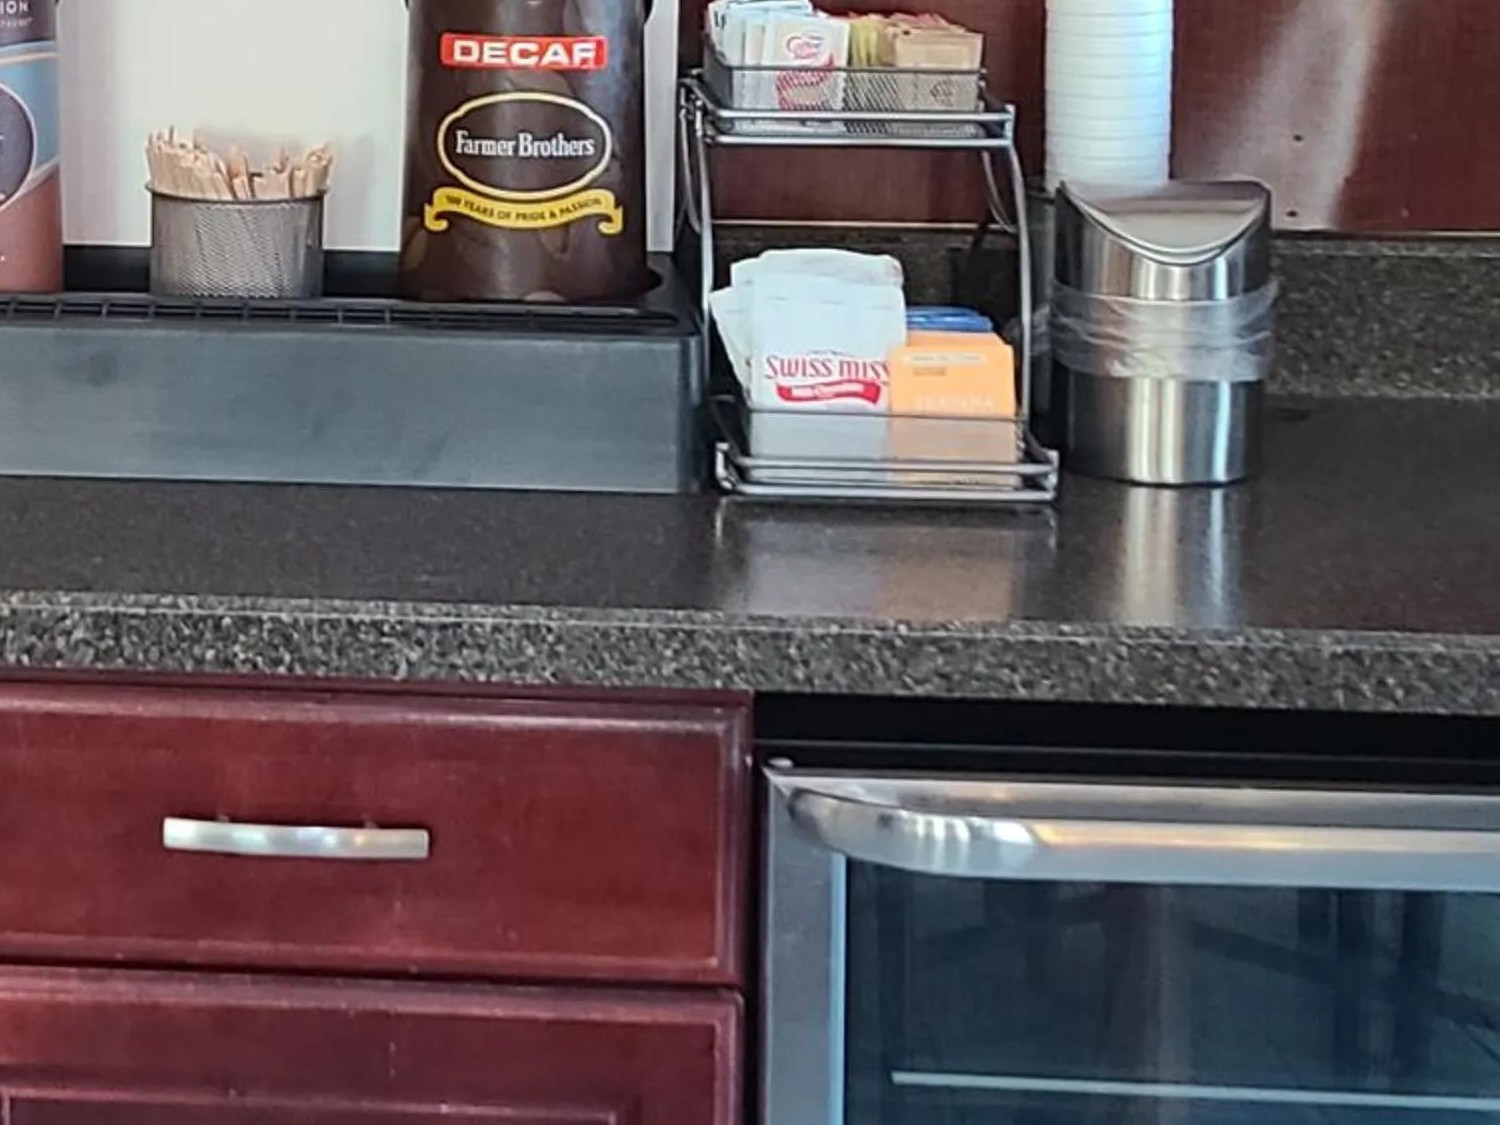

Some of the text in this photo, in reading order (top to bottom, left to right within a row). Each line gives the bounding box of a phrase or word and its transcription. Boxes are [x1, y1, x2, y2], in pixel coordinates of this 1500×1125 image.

[452, 40, 597, 66] DECAF
[456, 130, 596, 157] Farmer Brothers
[464, 198, 495, 218] YEARS
[497, 210, 513, 220] OF
[515, 211, 546, 222] PRIDE
[559, 196, 603, 218] PASSION
